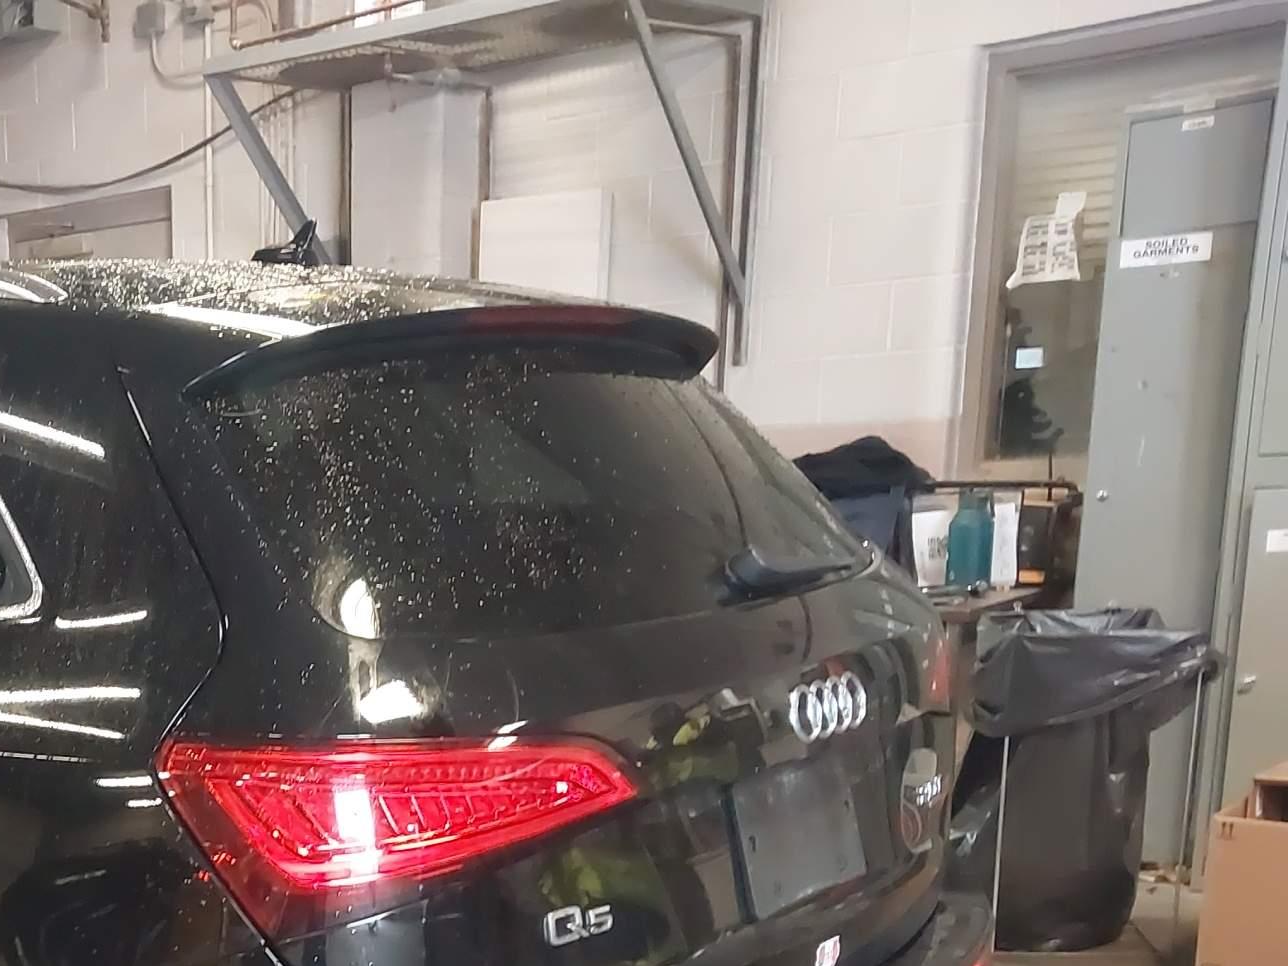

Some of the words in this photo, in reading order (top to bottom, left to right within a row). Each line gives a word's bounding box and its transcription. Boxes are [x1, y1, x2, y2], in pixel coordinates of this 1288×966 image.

[1145, 237, 1189, 249] SOILED
[1133, 245, 1199, 258] GARMENTS
[544, 904, 613, 946] Q5
